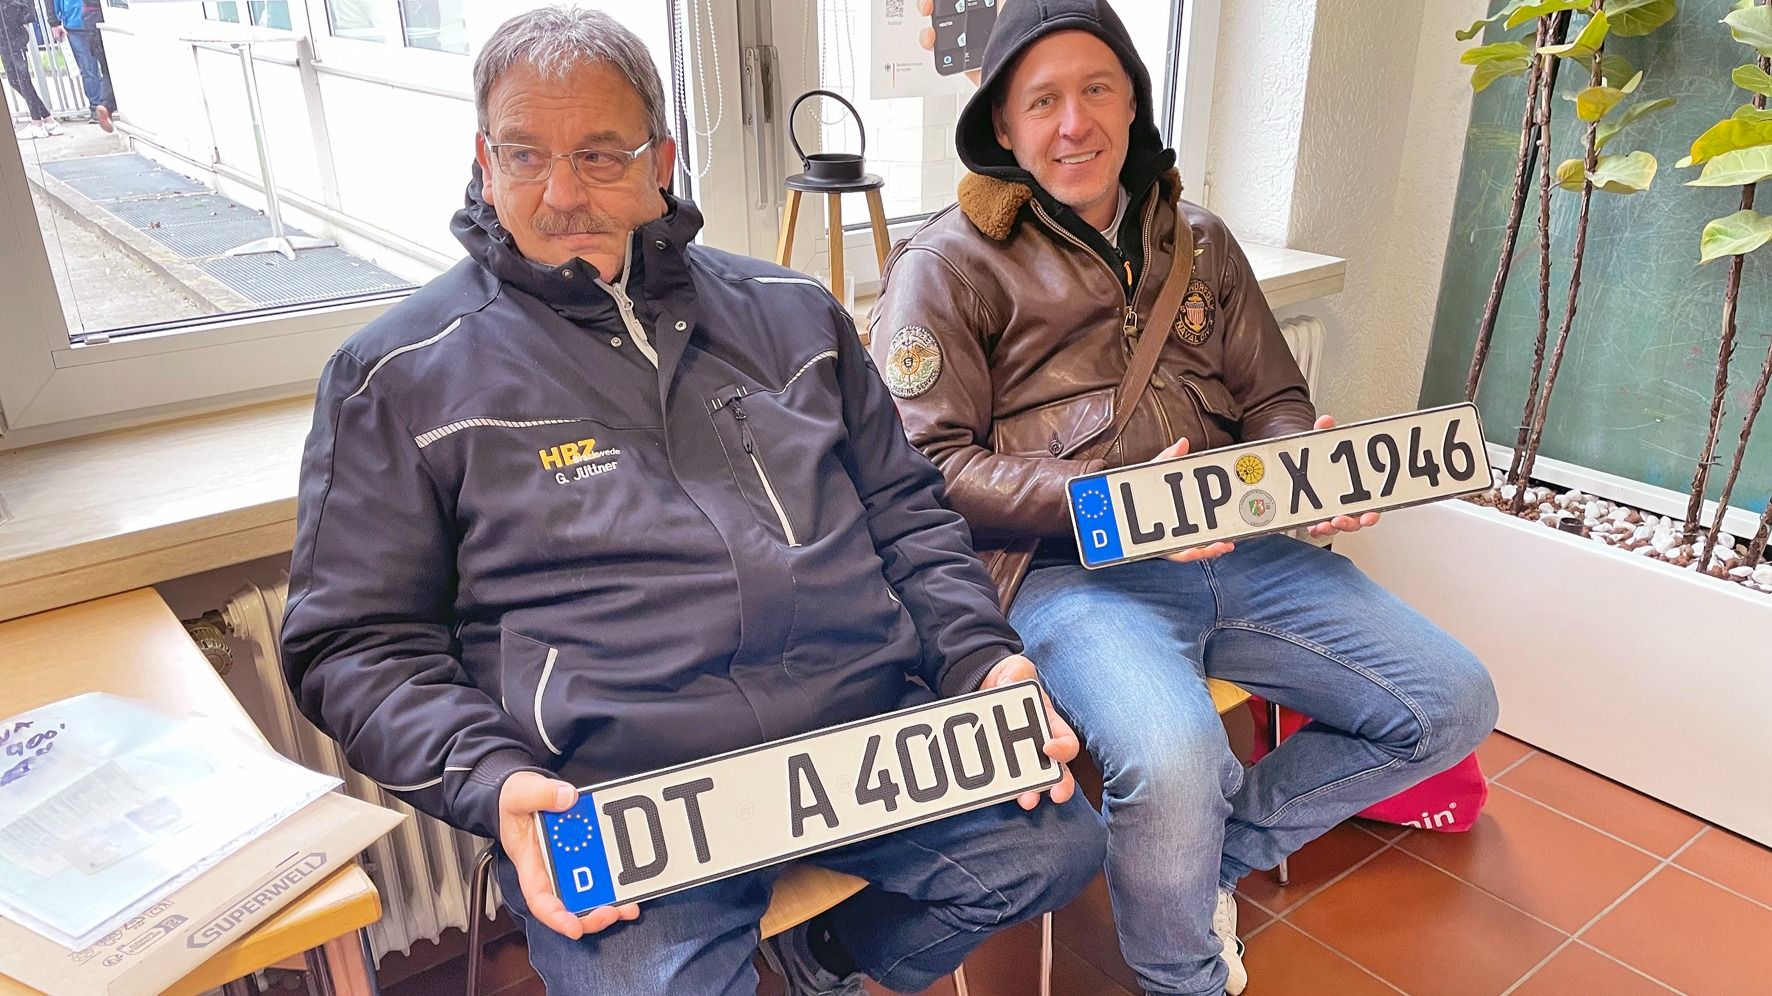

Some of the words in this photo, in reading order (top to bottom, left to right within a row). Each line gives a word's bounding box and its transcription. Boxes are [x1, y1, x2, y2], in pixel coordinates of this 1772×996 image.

[1176, 321, 1198, 342] NAVAL
[539, 438, 596, 470] HBZ
[555, 472, 570, 485] G.
[1119, 465, 1232, 546] LIP
[1279, 447, 1322, 515] X
[1330, 419, 1476, 505] 1946
[1093, 529, 1108, 549] D
[602, 777, 714, 886] DT
[788, 753, 840, 838] A
[855, 697, 1052, 812] 400H
[573, 866, 593, 892] D
[201, 861, 320, 939] SUPERWELL
